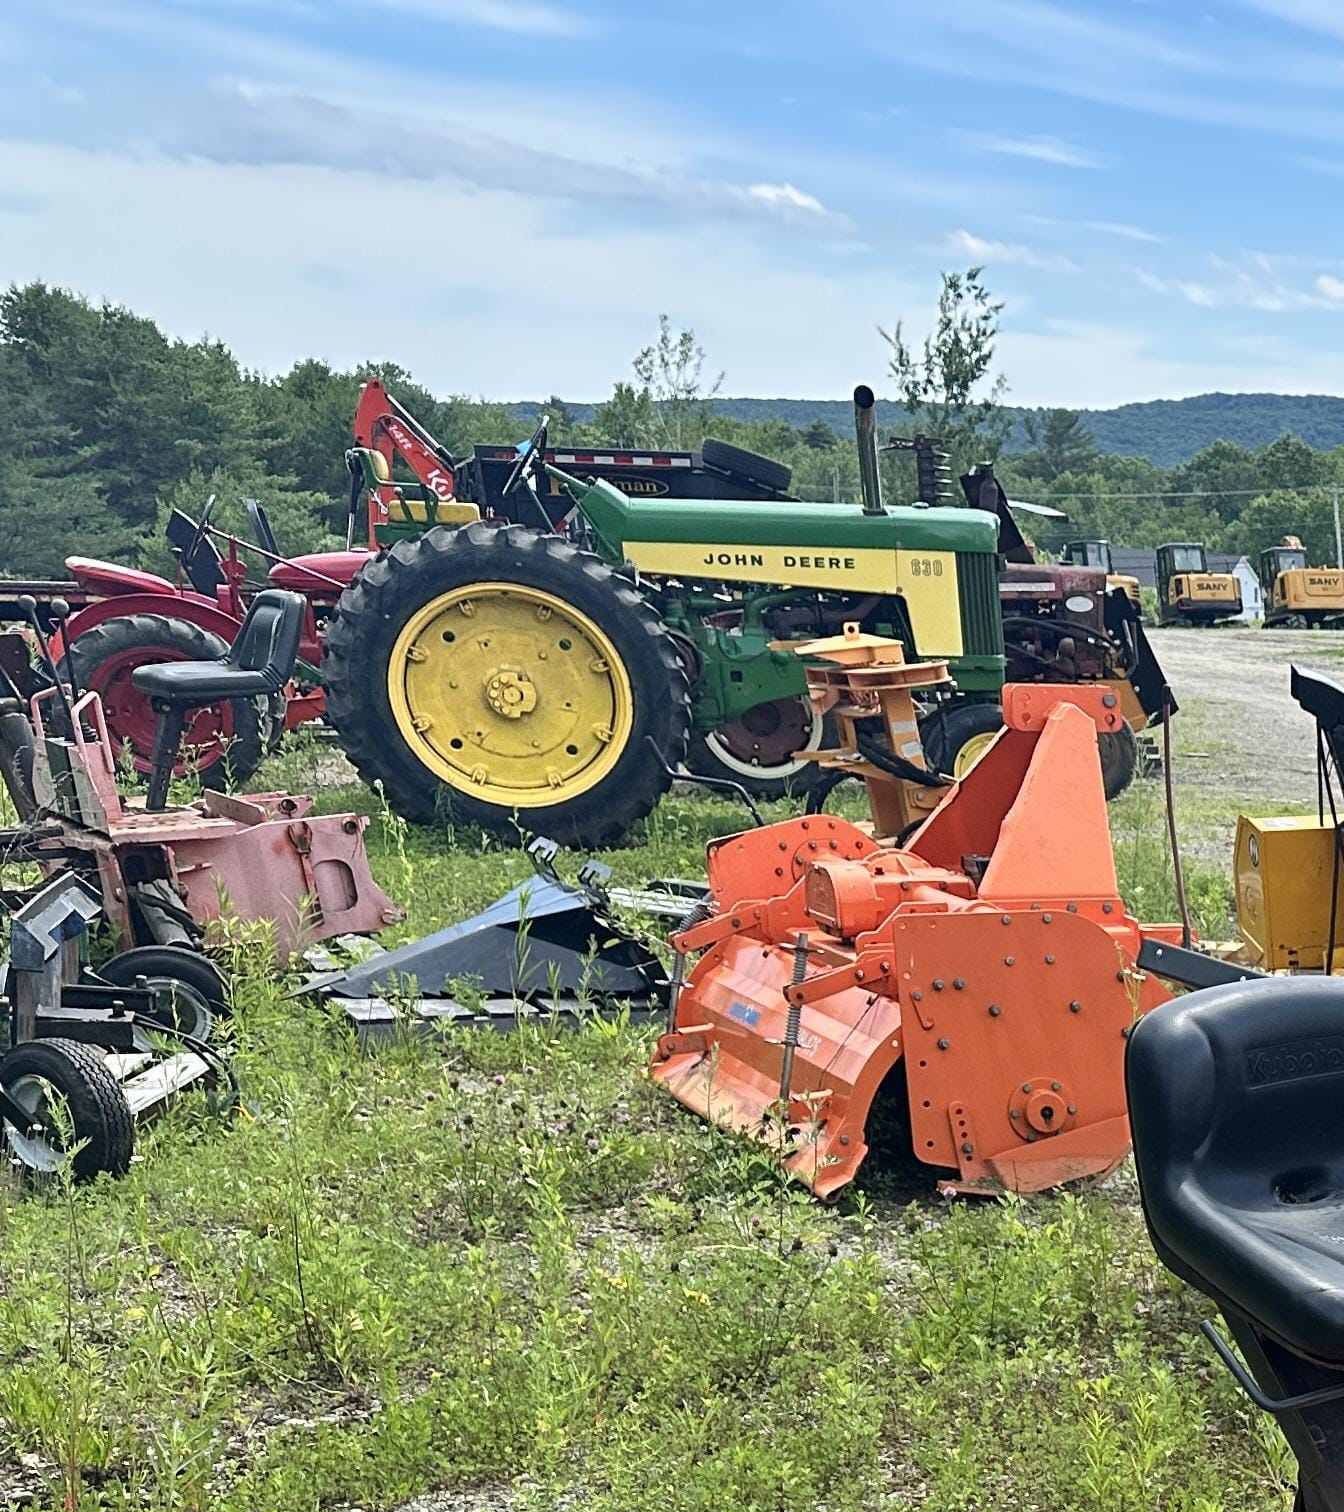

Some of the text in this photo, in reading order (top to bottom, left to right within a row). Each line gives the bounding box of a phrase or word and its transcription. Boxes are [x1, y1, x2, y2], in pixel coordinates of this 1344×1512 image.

[703, 552, 856, 570] JOHN DEERE
[911, 558, 944, 577] 630
[1196, 582, 1229, 592] SANY
[1308, 577, 1341, 587] SANY
